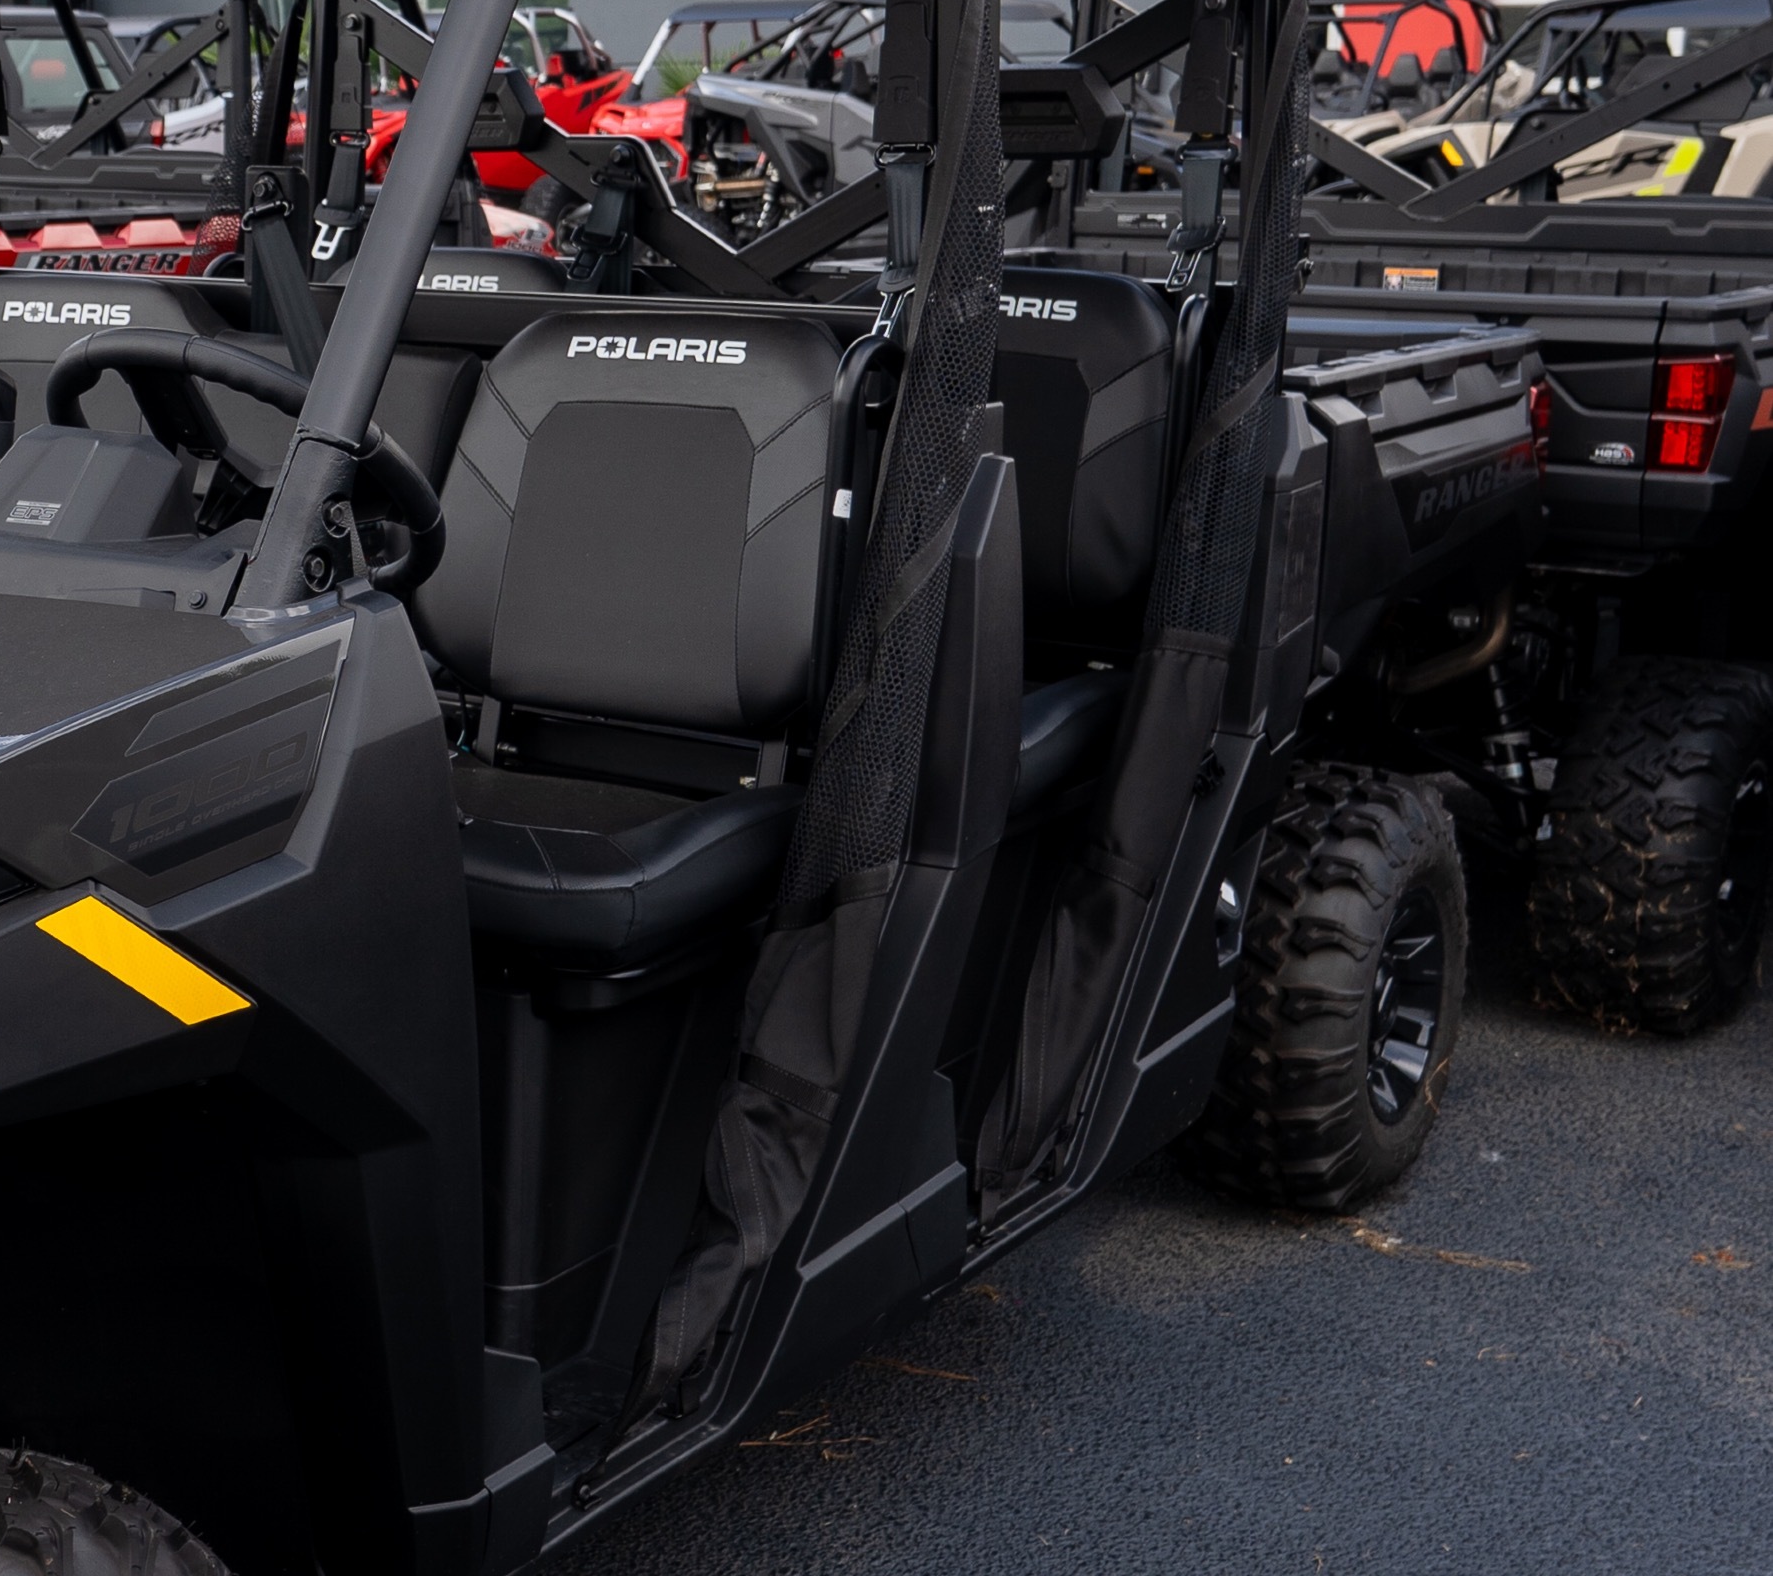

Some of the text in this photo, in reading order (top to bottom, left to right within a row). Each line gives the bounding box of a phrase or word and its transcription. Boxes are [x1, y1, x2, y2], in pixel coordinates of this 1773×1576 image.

[35, 252, 180, 274] RANGER
[416, 274, 499, 292] LARIS
[2, 301, 131, 325] POLARIS
[999, 295, 1077, 322] ARIS
[567, 336, 747, 364] POLARIS
[1413, 453, 1530, 524] RANGER
[9, 505, 58, 520] EPS
[109, 731, 308, 844] 1000
